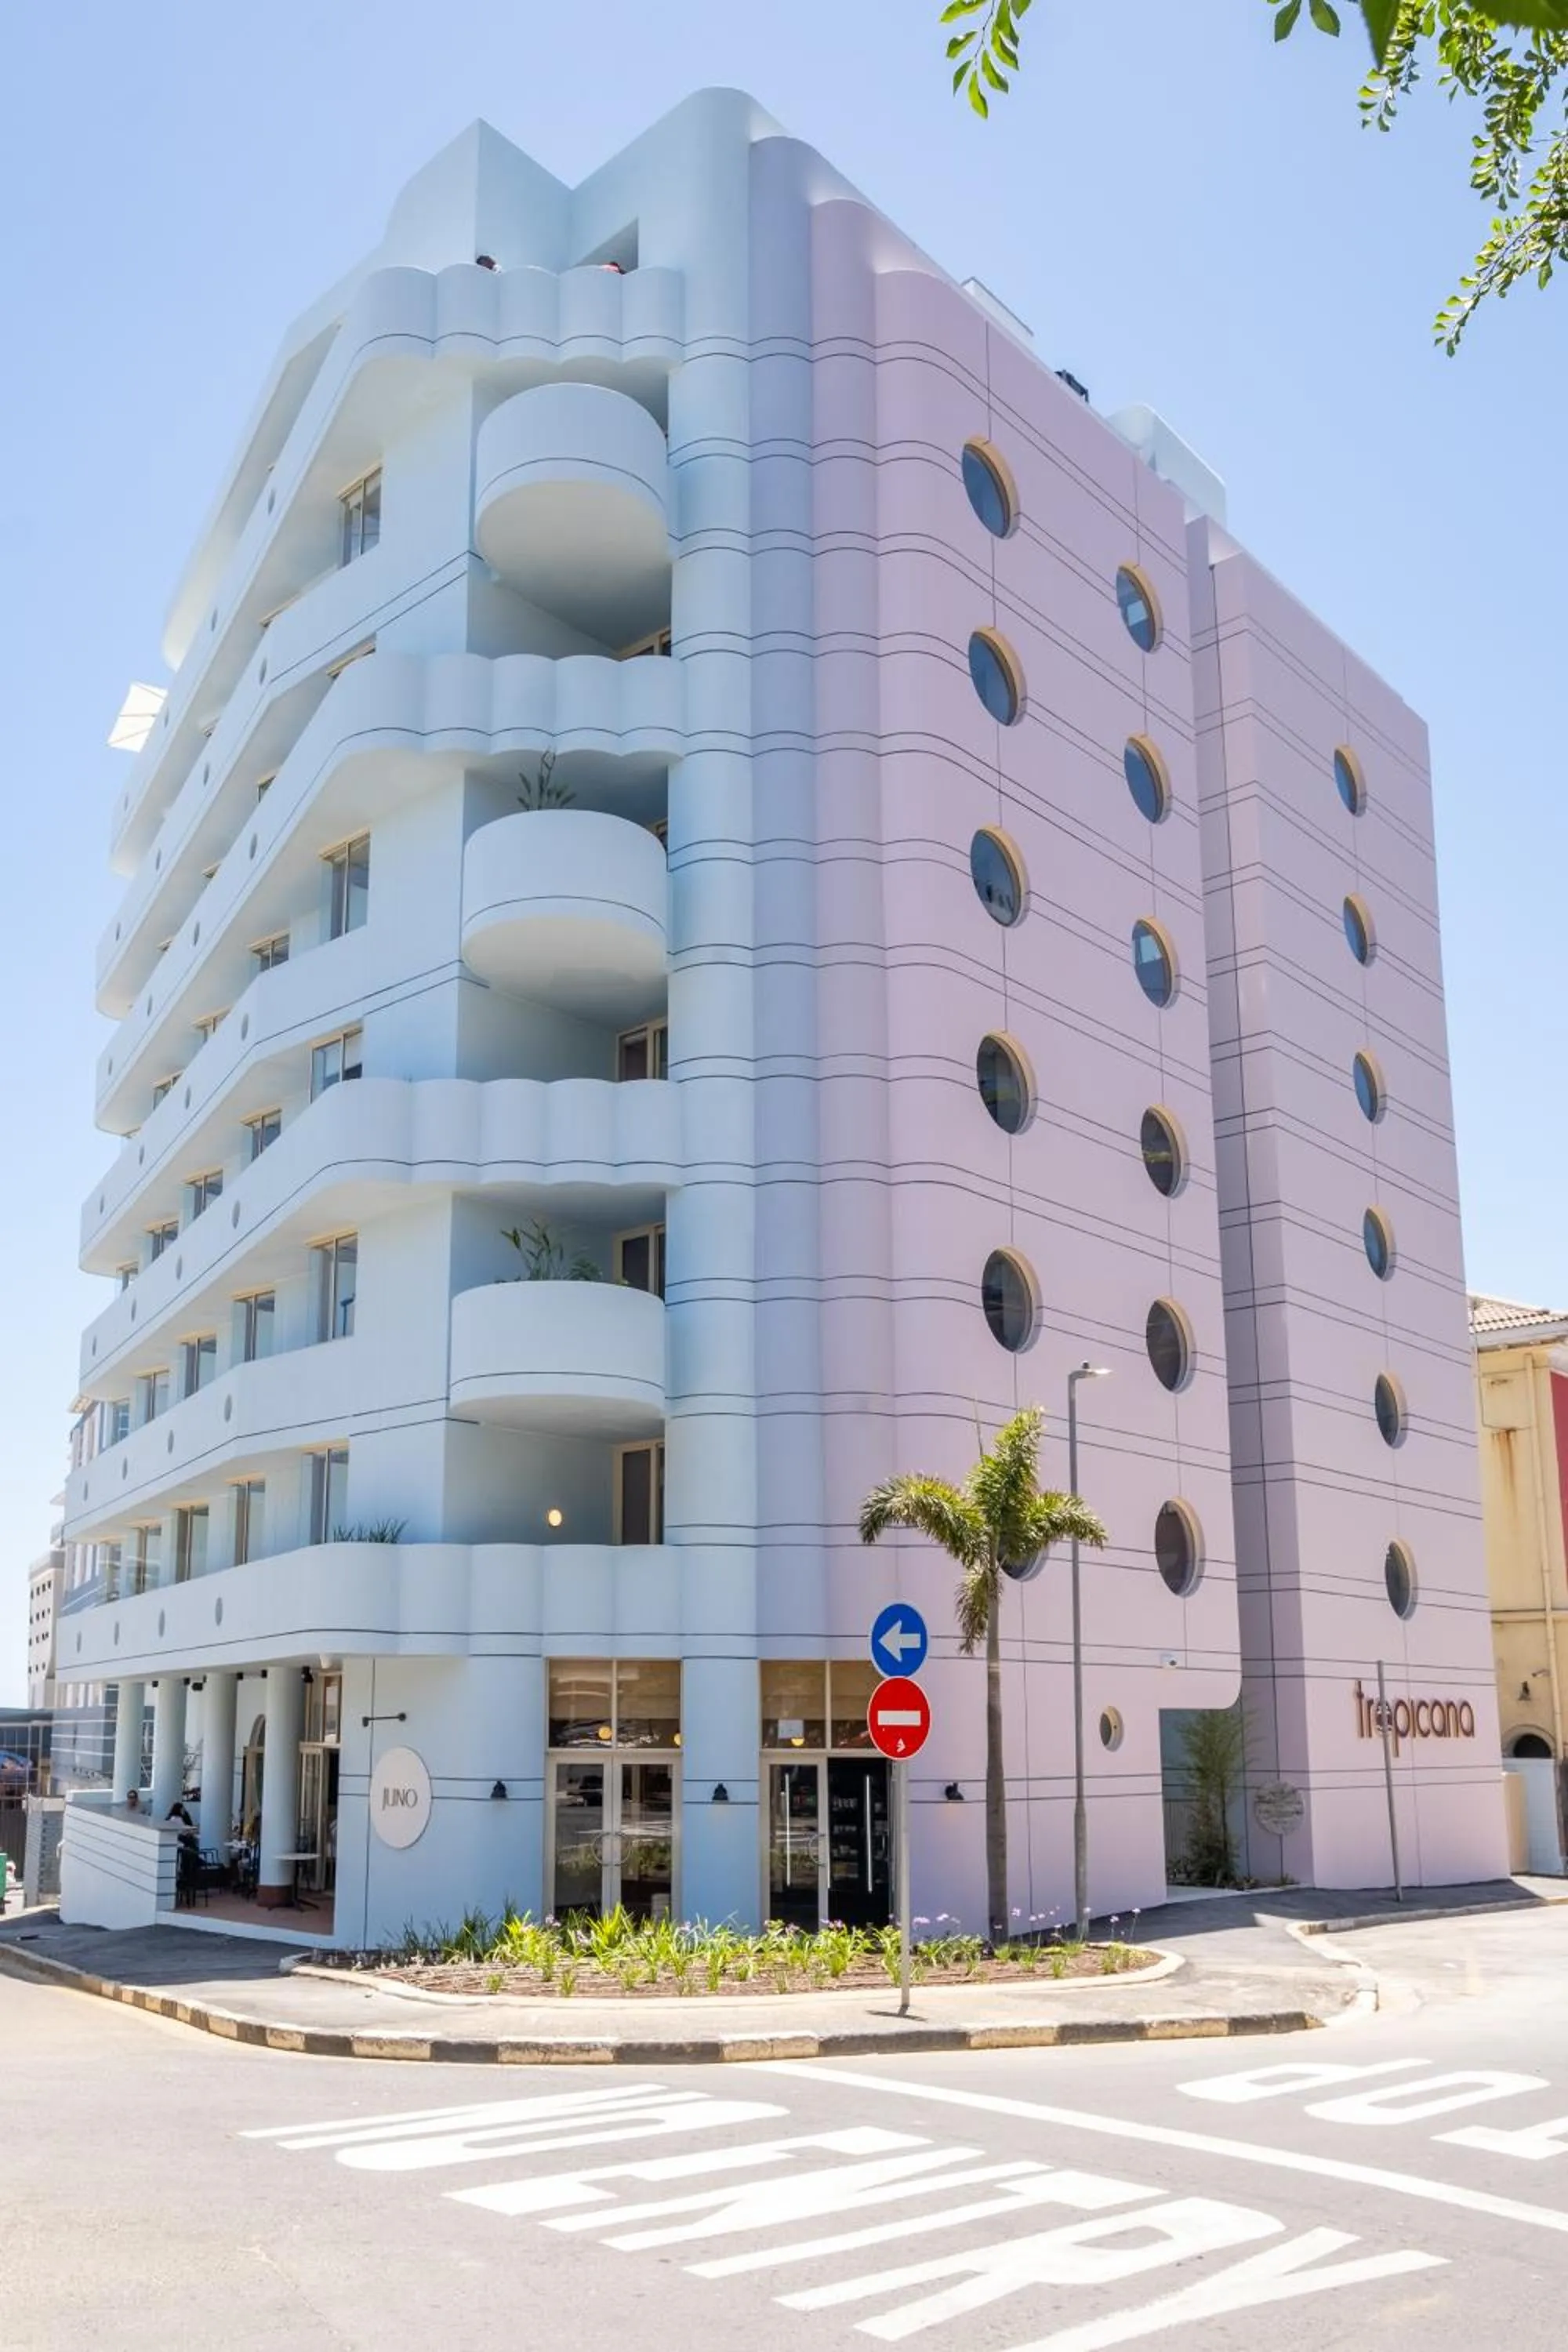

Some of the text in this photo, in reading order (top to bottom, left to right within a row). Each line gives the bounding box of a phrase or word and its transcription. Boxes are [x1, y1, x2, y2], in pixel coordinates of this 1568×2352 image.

[383, 1788, 418, 1810] JUNO
[238, 2083, 1450, 2352] NO ENTRY
